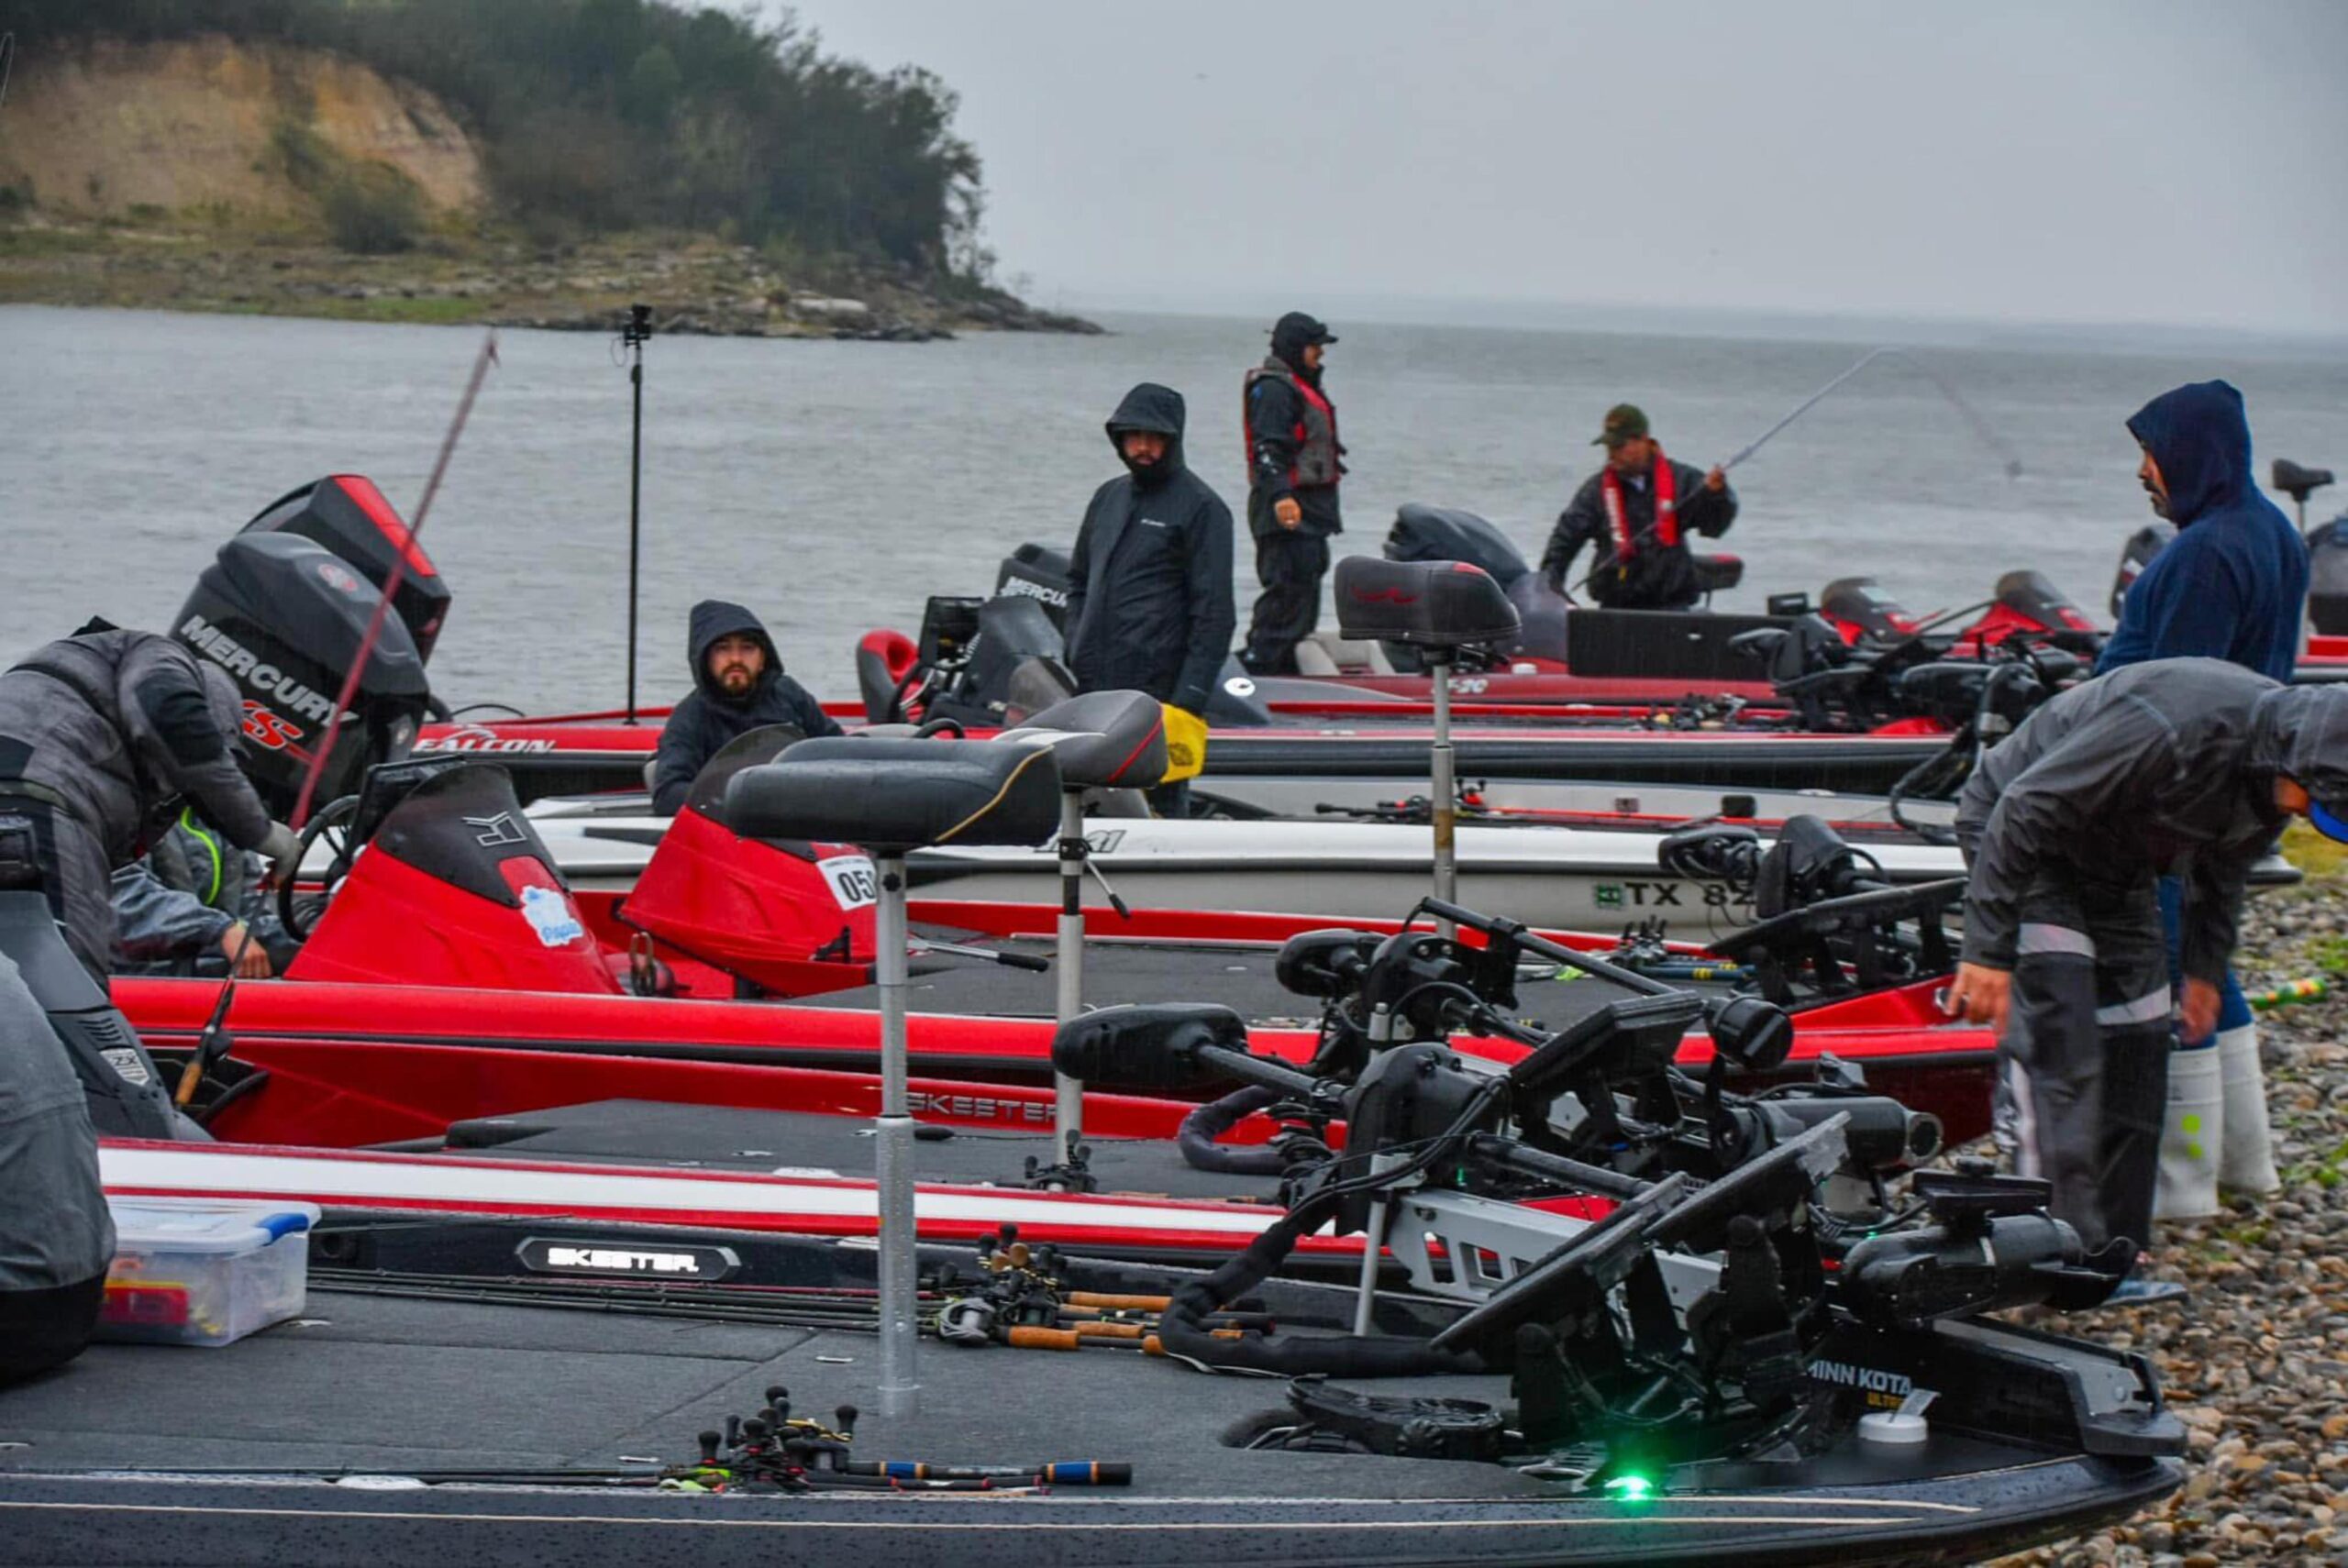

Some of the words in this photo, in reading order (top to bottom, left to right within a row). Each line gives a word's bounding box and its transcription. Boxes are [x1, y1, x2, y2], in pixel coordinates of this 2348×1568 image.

[180, 614, 360, 727] MERCURY
[411, 738, 557, 752] FALCON
[1624, 881, 1682, 906] TX
[548, 1247, 700, 1273] SKEETER
[1858, 1367, 1912, 1396] KOTA
